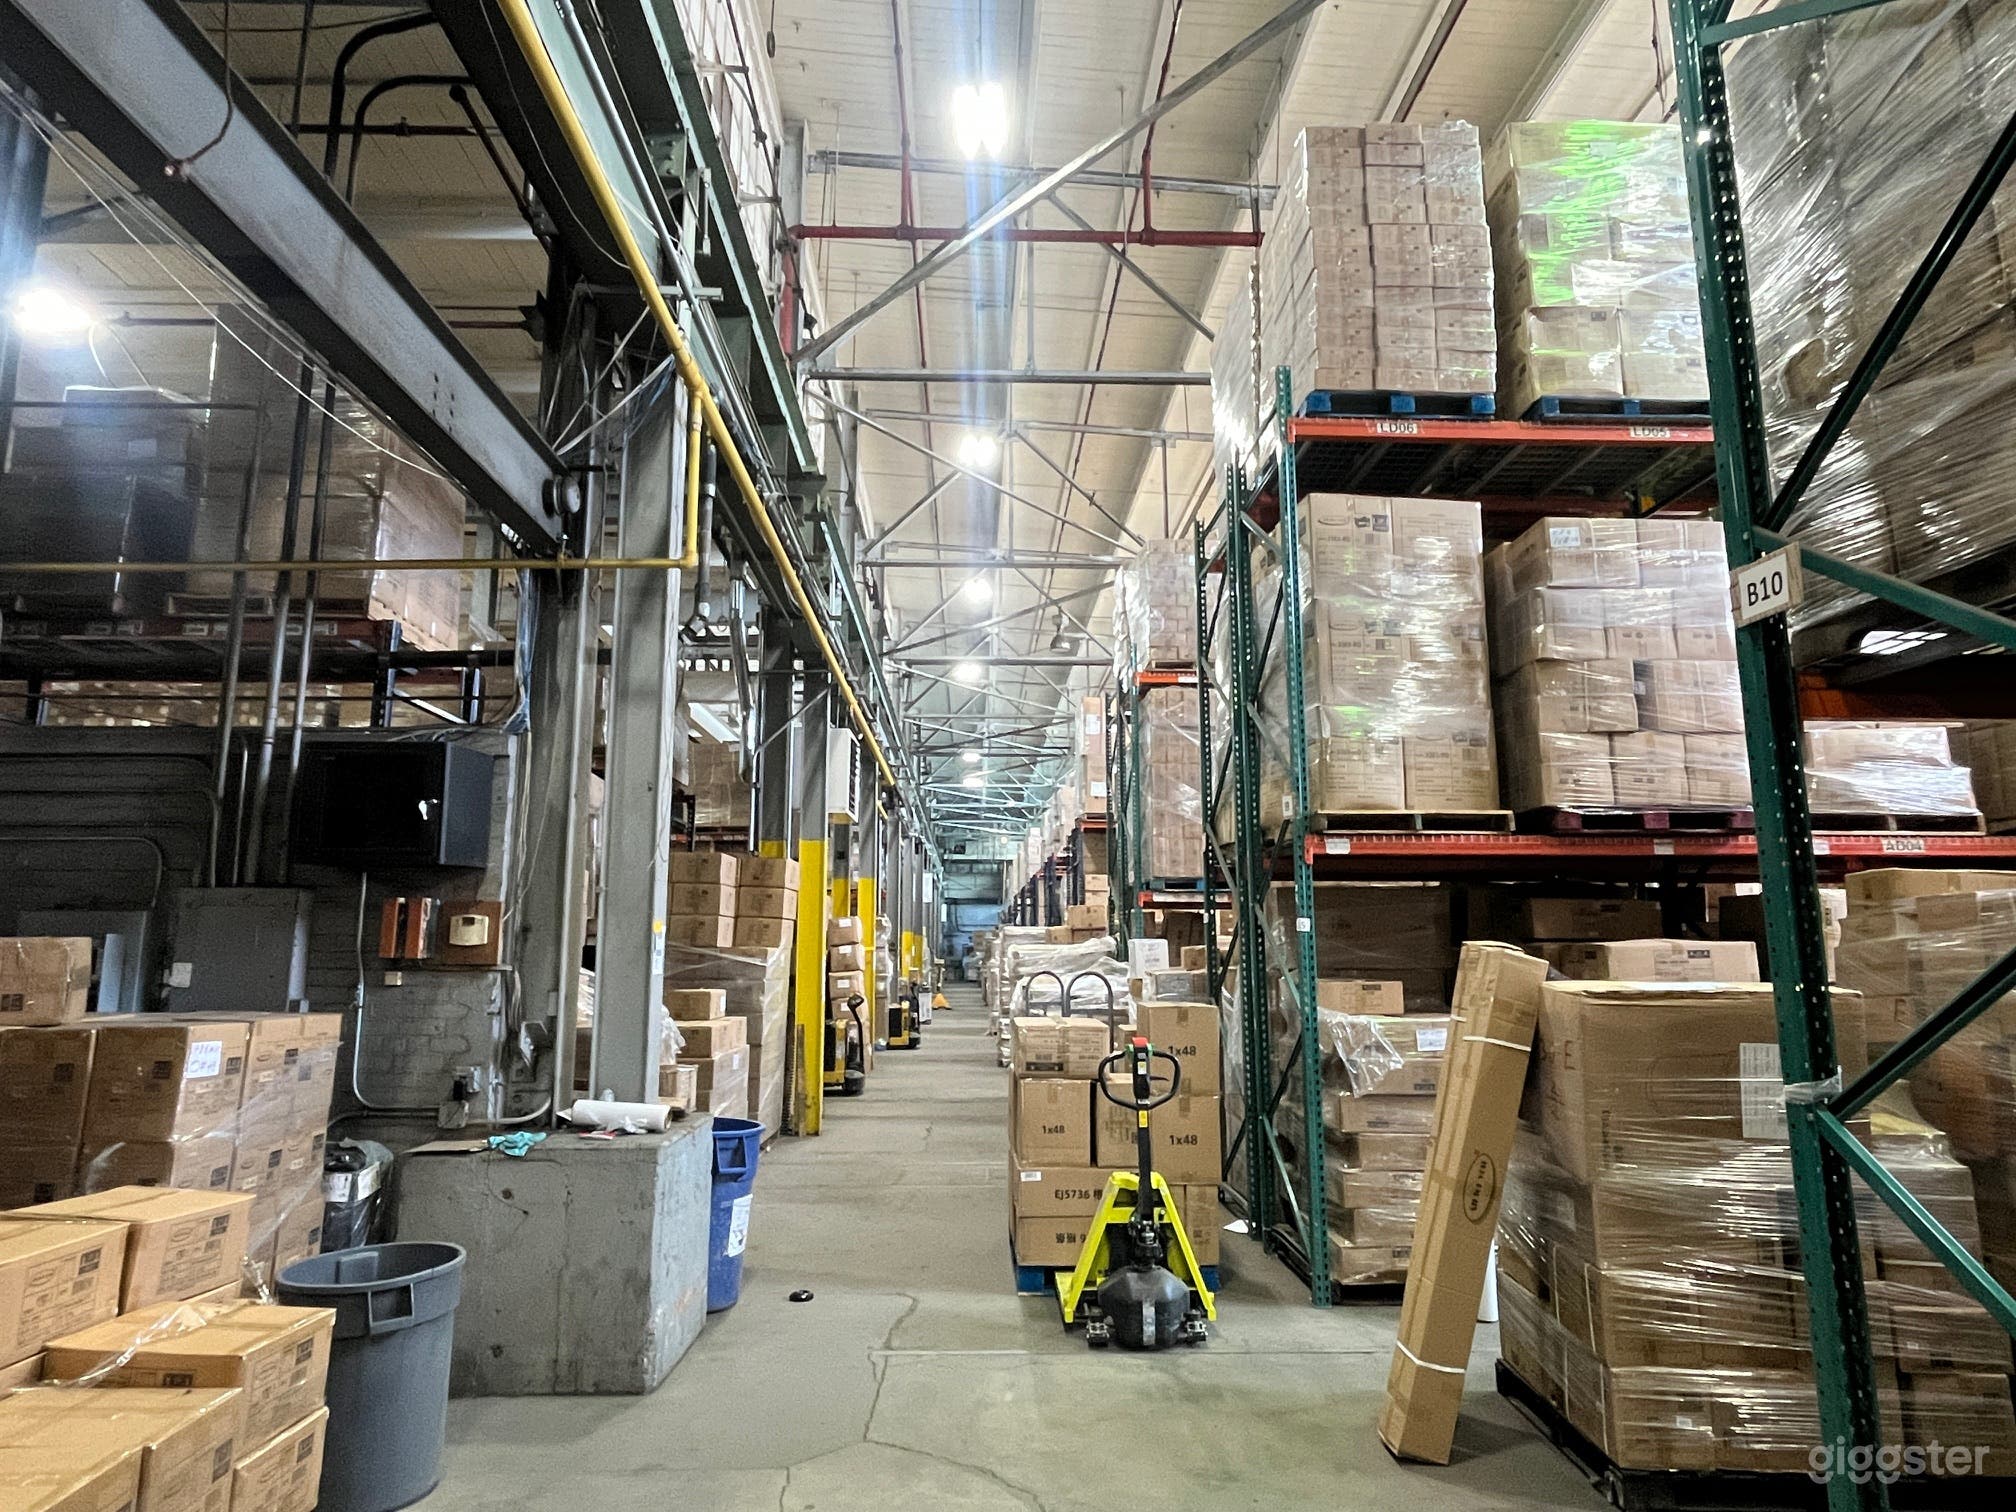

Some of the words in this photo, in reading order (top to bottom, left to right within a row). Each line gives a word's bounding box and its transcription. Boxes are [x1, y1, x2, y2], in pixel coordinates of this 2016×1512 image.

[1380, 422, 1415, 433] LD06
[1747, 570, 1783, 607] B10
[1167, 1045, 1197, 1056] 1x48
[1042, 1124, 1065, 1134] 1x48
[1169, 1134, 1198, 1146] 1x48
[1054, 1189, 1090, 1200] EJ5736
